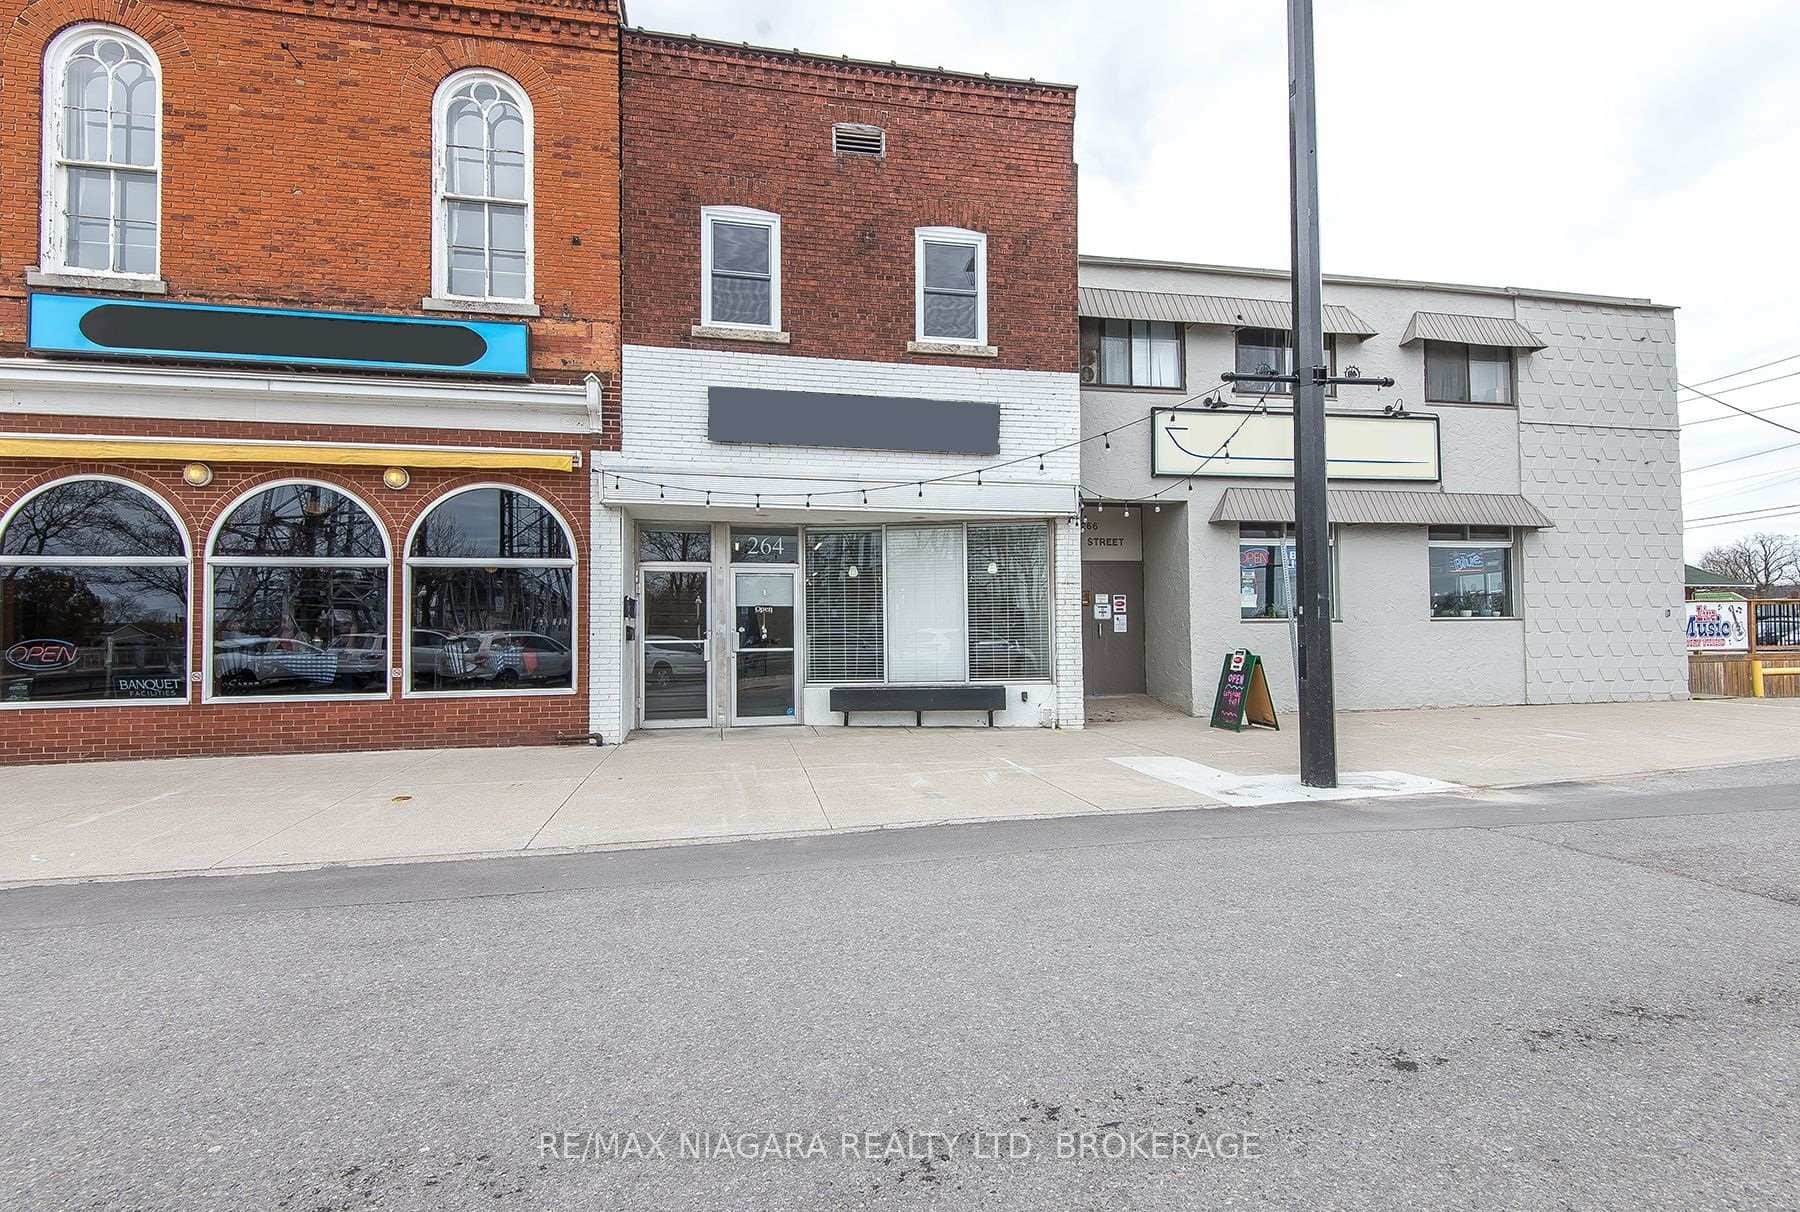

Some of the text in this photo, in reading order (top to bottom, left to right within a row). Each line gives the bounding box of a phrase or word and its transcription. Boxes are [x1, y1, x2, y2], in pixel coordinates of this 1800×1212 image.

[747, 536, 784, 555] 264
[1087, 537, 1125, 546] STREET
[754, 606, 774, 614] Open
[8, 646, 78, 663] OPEN
[119, 679, 180, 691] BANQUET
[129, 689, 177, 697] FACILITIES
